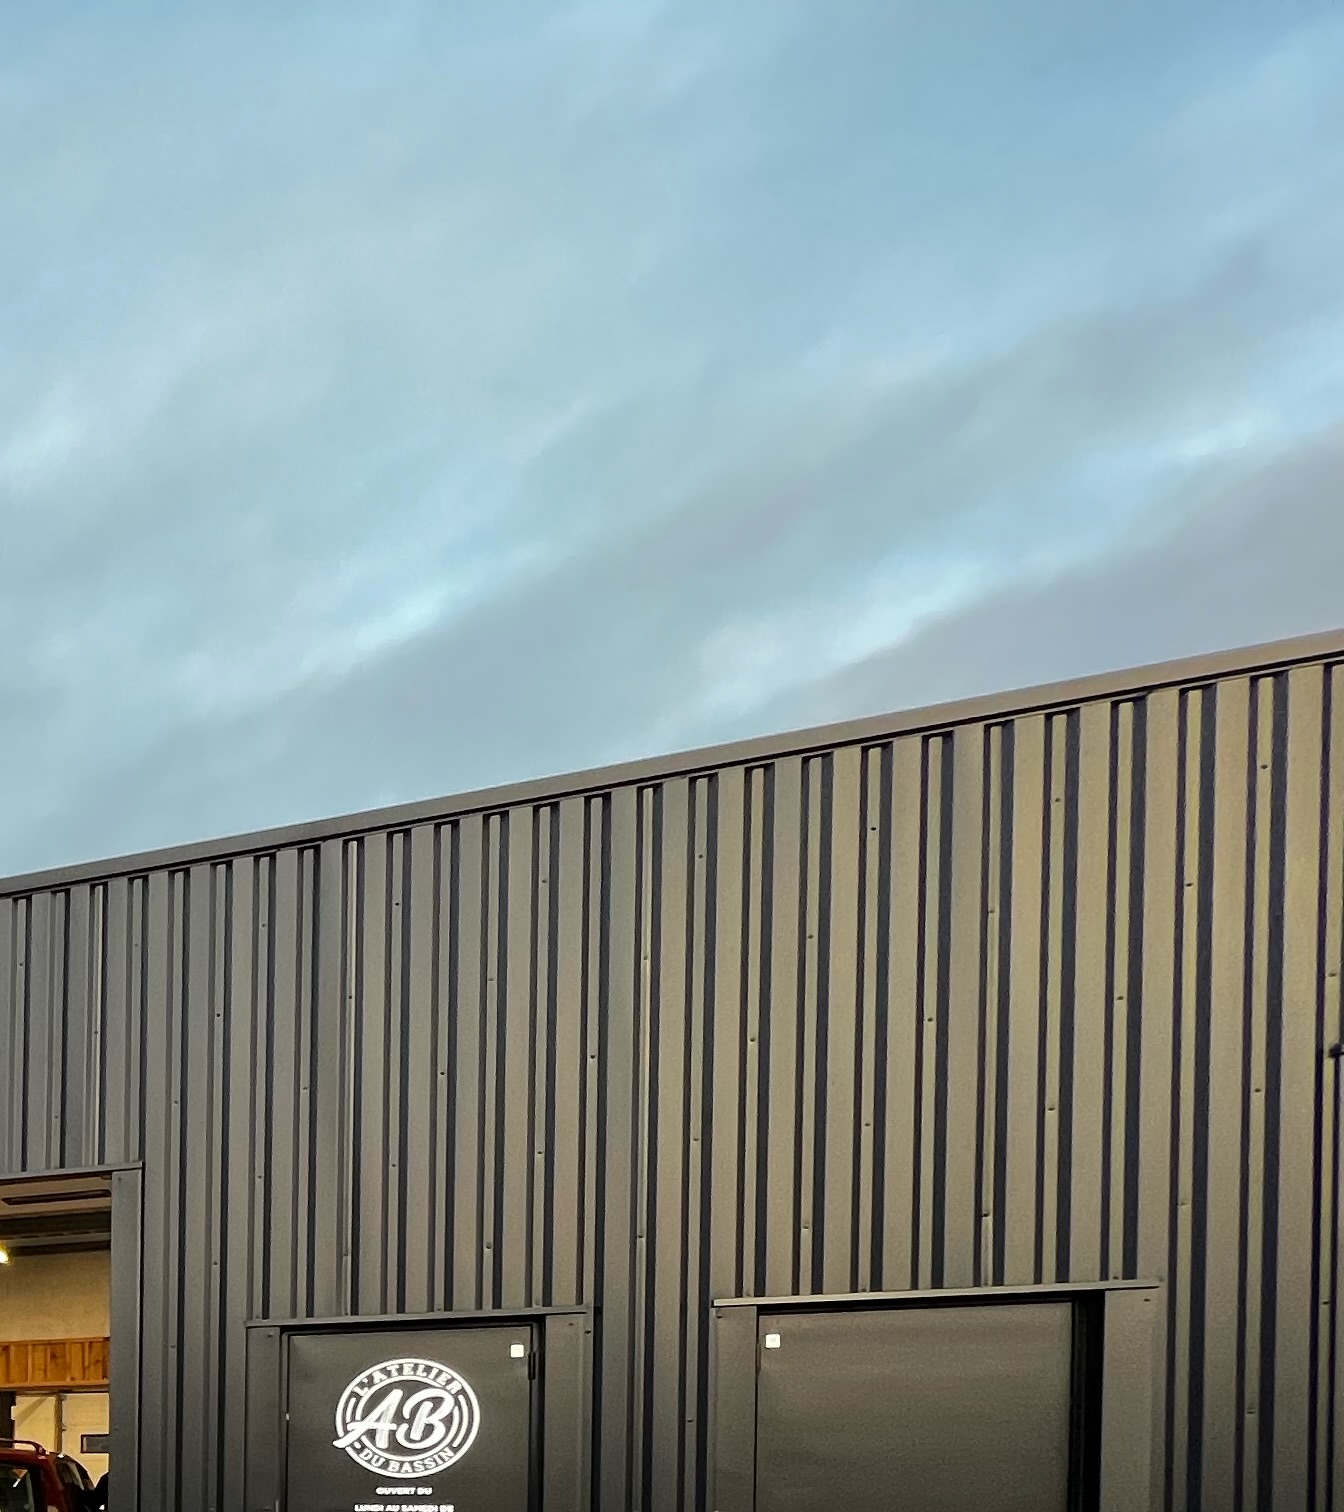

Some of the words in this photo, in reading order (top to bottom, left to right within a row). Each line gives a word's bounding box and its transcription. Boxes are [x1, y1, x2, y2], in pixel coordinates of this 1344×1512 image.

[352, 1363, 463, 1397] L'ATELIER
[332, 1387, 455, 1450] AB
[359, 1448, 385, 1468] DU
[387, 1447, 455, 1473] BASSIN
